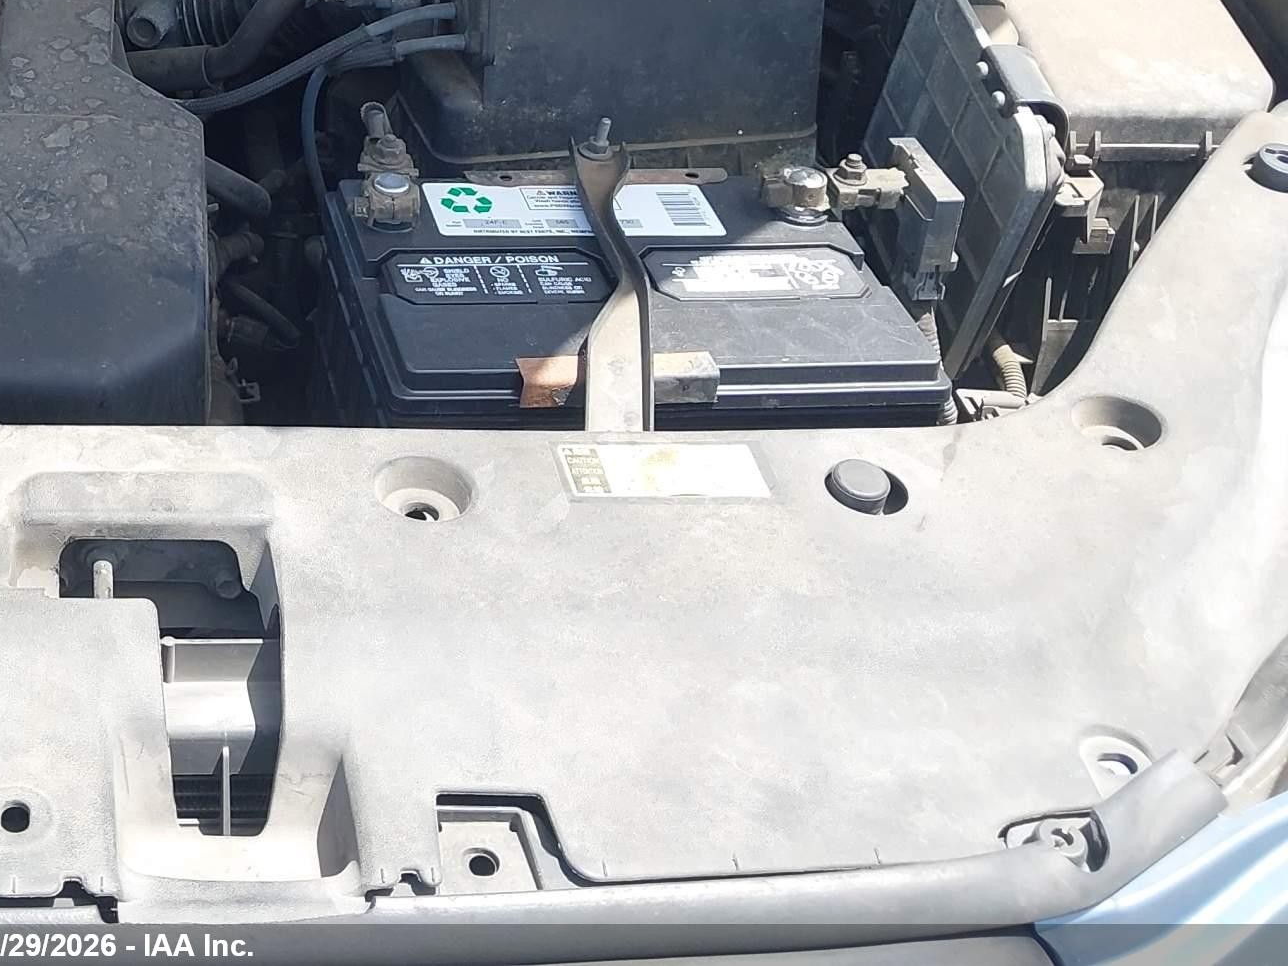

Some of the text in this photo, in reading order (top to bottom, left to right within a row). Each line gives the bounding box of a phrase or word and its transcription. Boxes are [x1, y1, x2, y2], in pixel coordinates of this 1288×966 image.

[433, 256, 492, 264] DANGER
[505, 255, 559, 263] POISON
[567, 456, 601, 464] CAUTION
[571, 467, 606, 475] ATTENTION
